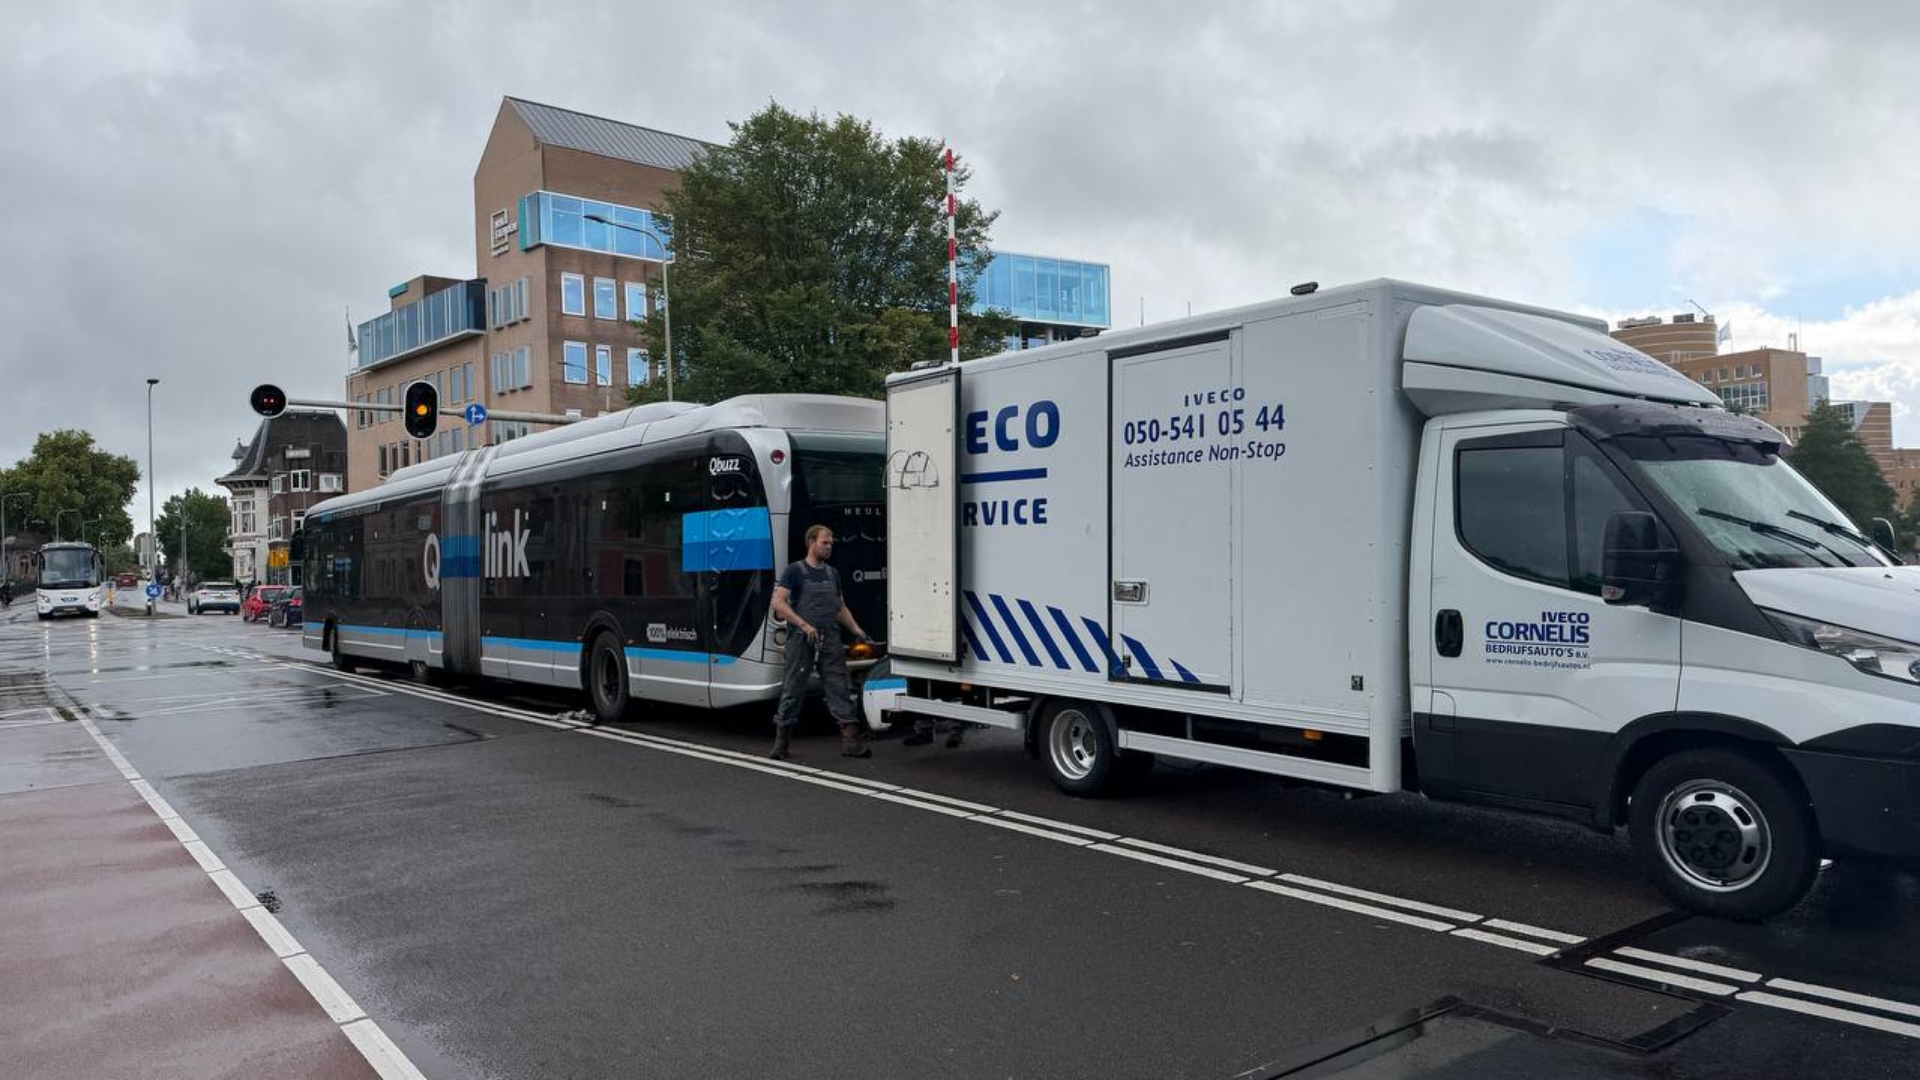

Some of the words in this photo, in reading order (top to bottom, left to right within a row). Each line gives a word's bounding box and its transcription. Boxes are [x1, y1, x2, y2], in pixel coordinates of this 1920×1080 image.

[1184, 387, 1245, 407] IVECO
[966, 400, 1060, 455] ECO
[1124, 413, 1205, 445] 050-541
[1218, 409, 1245, 436] 05
[1255, 403, 1286, 432] 44
[1124, 449, 1204, 468] Assistance
[1208, 441, 1286, 461] Non-Stop
[709, 457, 740, 476] Qbuzz
[844, 507, 882, 516] HEUL
[963, 498, 1047, 526] RVICE
[424, 533, 440, 590] Q
[484, 508, 530, 578] link
[1541, 611, 1590, 624] IVECO
[1485, 621, 1590, 644] CORNELIS
[1485, 644, 1574, 658] BEDRIJFSAUTO'S
